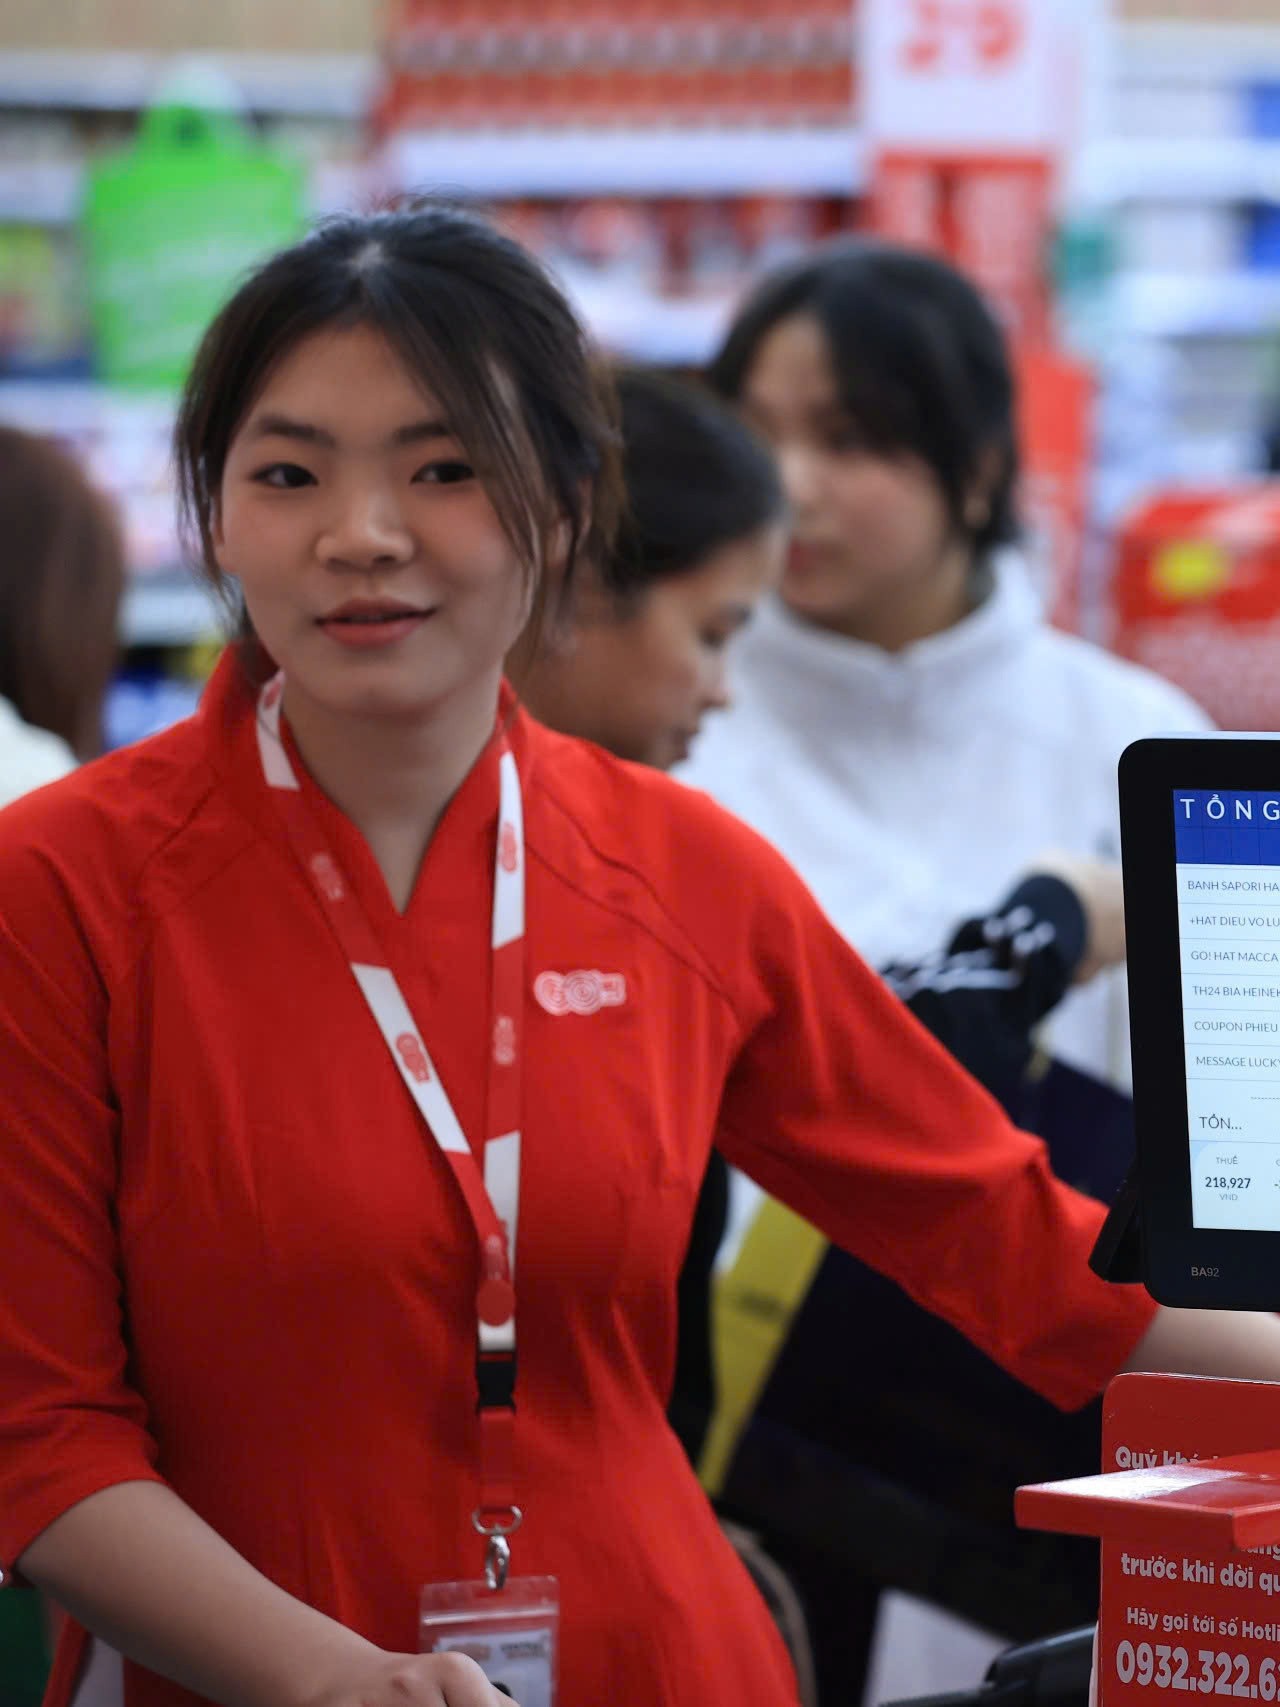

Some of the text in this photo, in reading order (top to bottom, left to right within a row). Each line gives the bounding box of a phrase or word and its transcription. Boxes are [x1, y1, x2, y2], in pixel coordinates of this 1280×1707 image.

[1180, 794, 1280, 821] TỔNG
[1188, 881, 1219, 891] BANH
[1221, 881, 1261, 892] SAPORI
[1190, 916, 1217, 926] +HAT
[1220, 916, 1246, 927] DIEU
[1248, 917, 1264, 927] VO
[1191, 951, 1212, 961] GO!
[1214, 951, 1236, 961] HAT
[1238, 952, 1279, 962] MACCA
[1192, 986, 1220, 996] TH24
[1223, 986, 1241, 997] BIA
[1194, 1021, 1243, 1032] COUPON
[1245, 1022, 1278, 1033] PHIEU
[1196, 1056, 1246, 1067] MESSAGE
[1205, 1176, 1251, 1190] 218,927
[1191, 1266, 1220, 1278] BA92
[1115, 1446, 1158, 1469] Quý
[1121, 1552, 1178, 1580] trước
[1182, 1559, 1215, 1586] khi
[1220, 1562, 1254, 1589] dời
[1127, 1607, 1159, 1630] Hãy
[1162, 1612, 1188, 1634] gọi
[1192, 1614, 1215, 1634] tới
[1219, 1616, 1240, 1637] số
